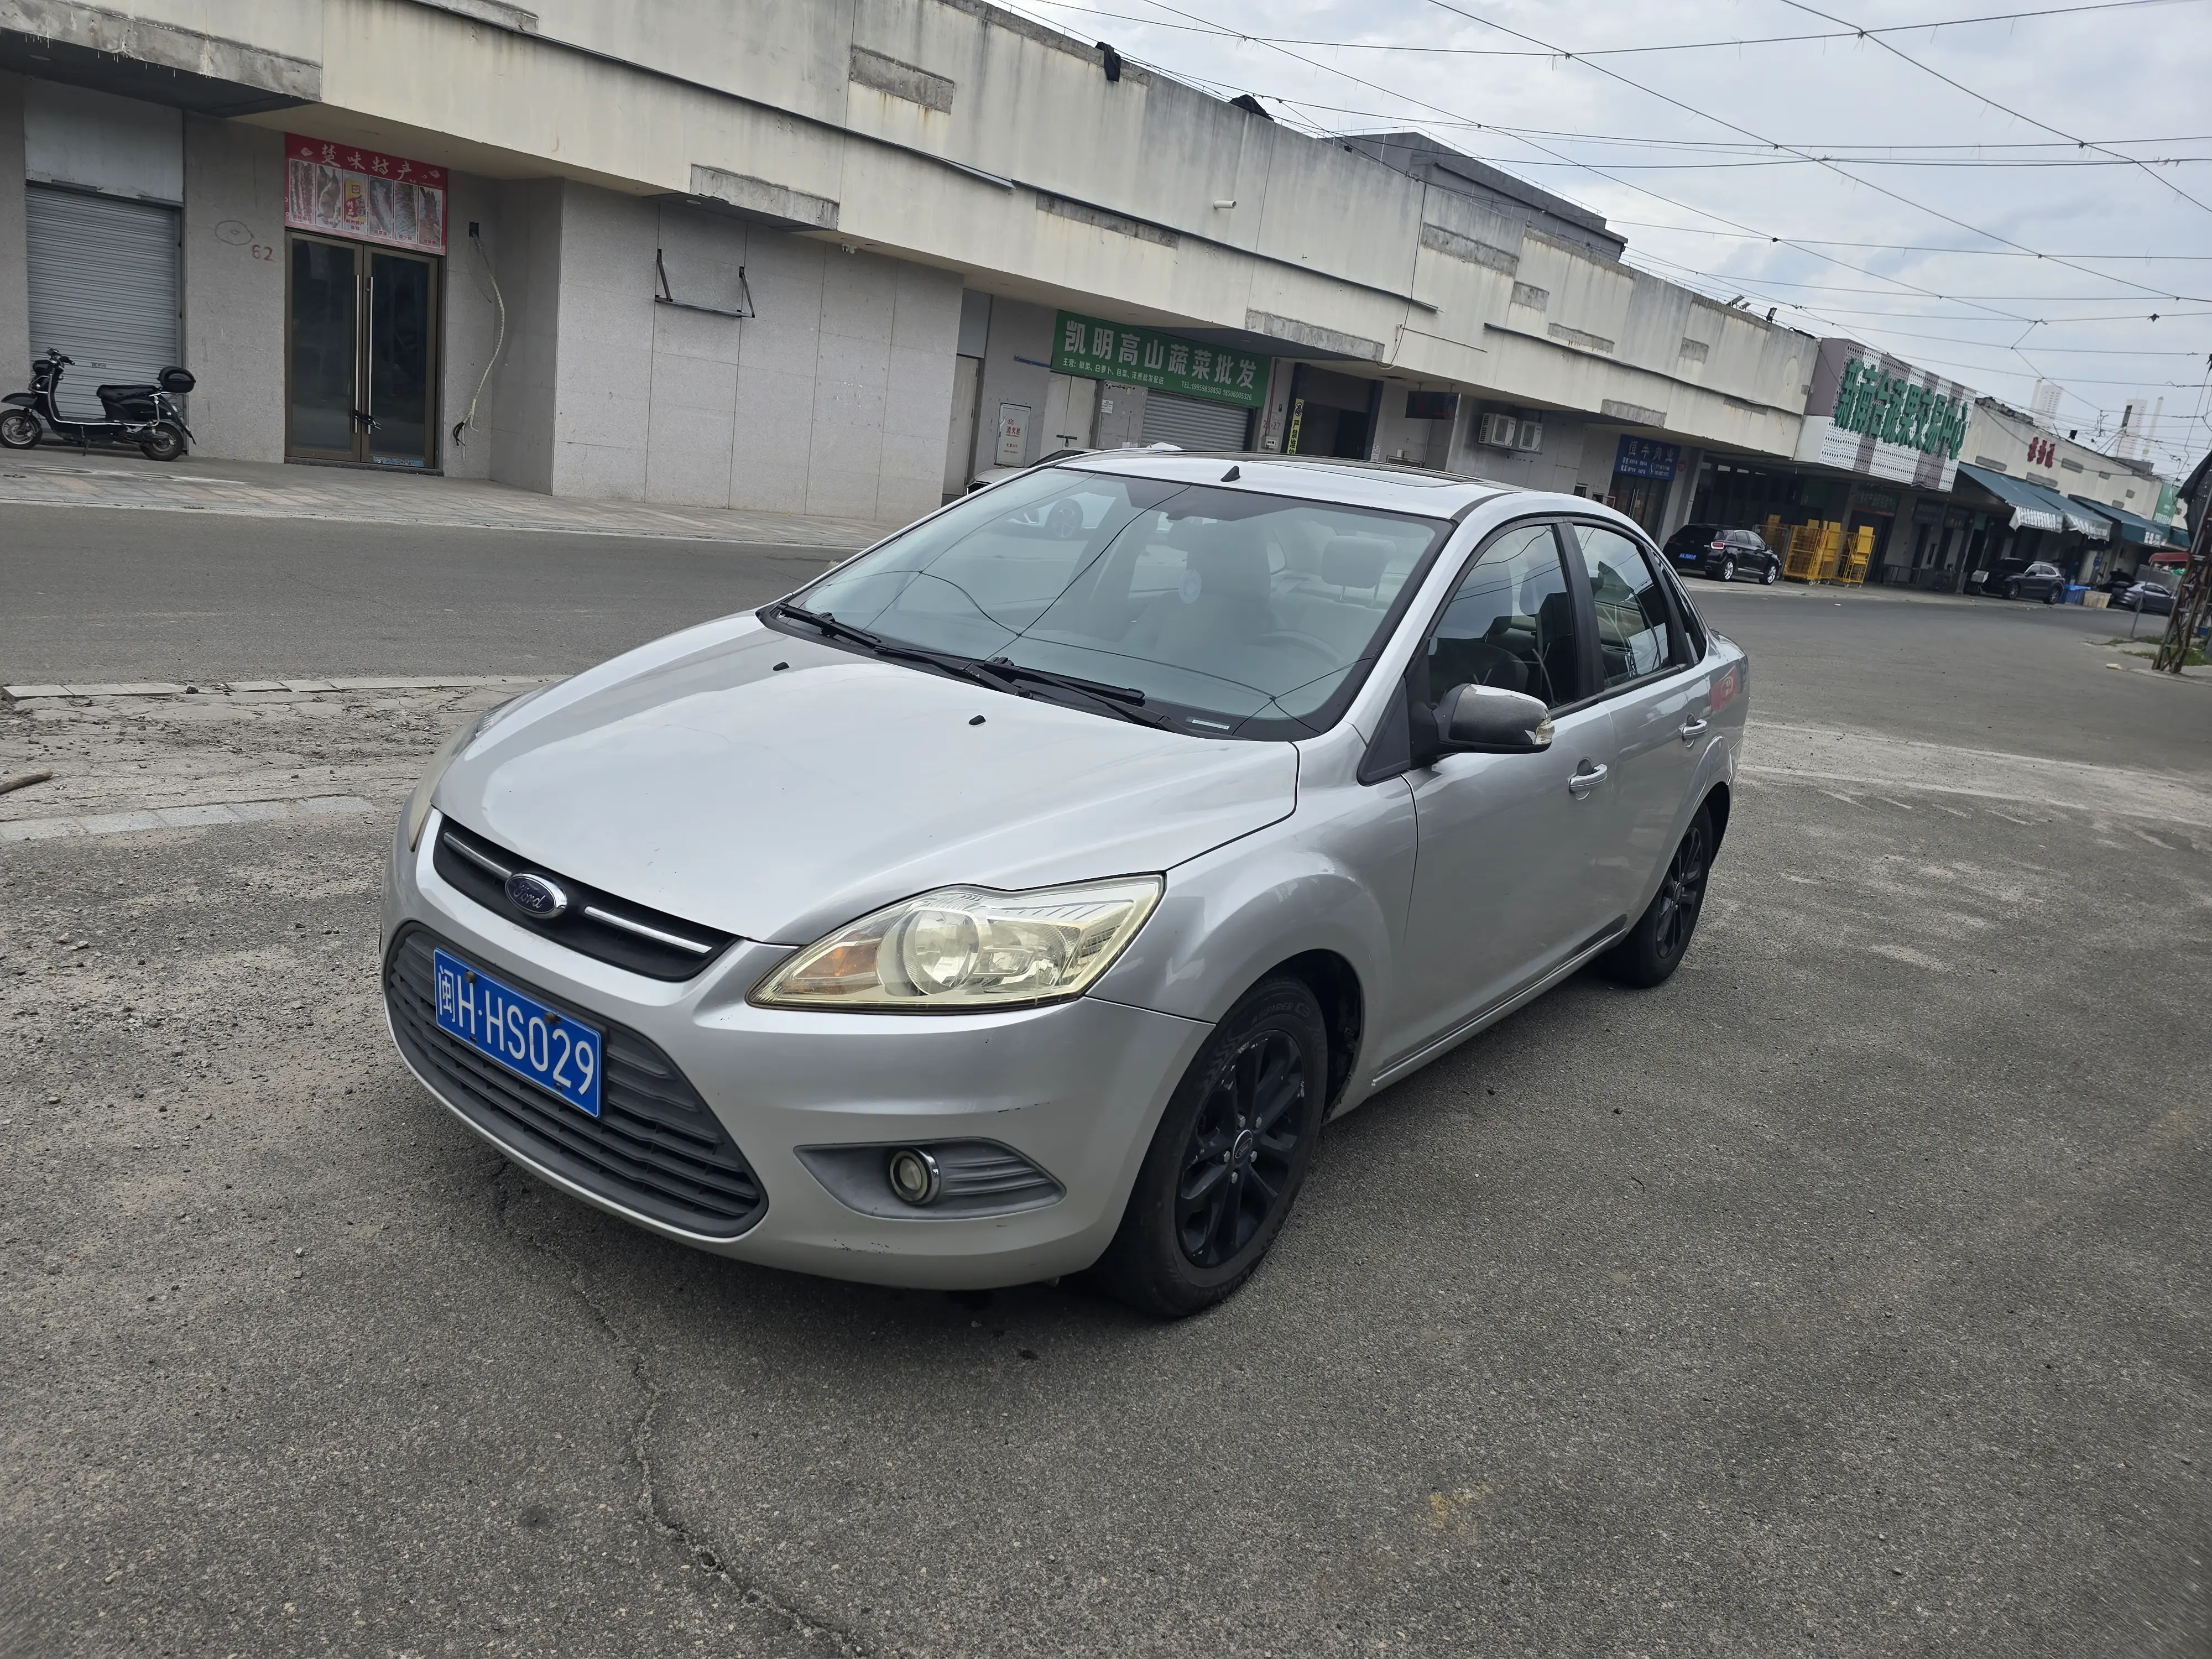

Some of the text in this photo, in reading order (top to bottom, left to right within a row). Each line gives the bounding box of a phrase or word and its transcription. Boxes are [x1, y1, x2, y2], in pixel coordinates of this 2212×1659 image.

[322, 144, 412, 180] 楚味特产
[252, 244, 274, 261] 62
[1064, 320, 1256, 389] 凯明高山蔬菜批发
[1006, 426, 1021, 435] 消火栓
[513, 880, 546, 909] Ford
